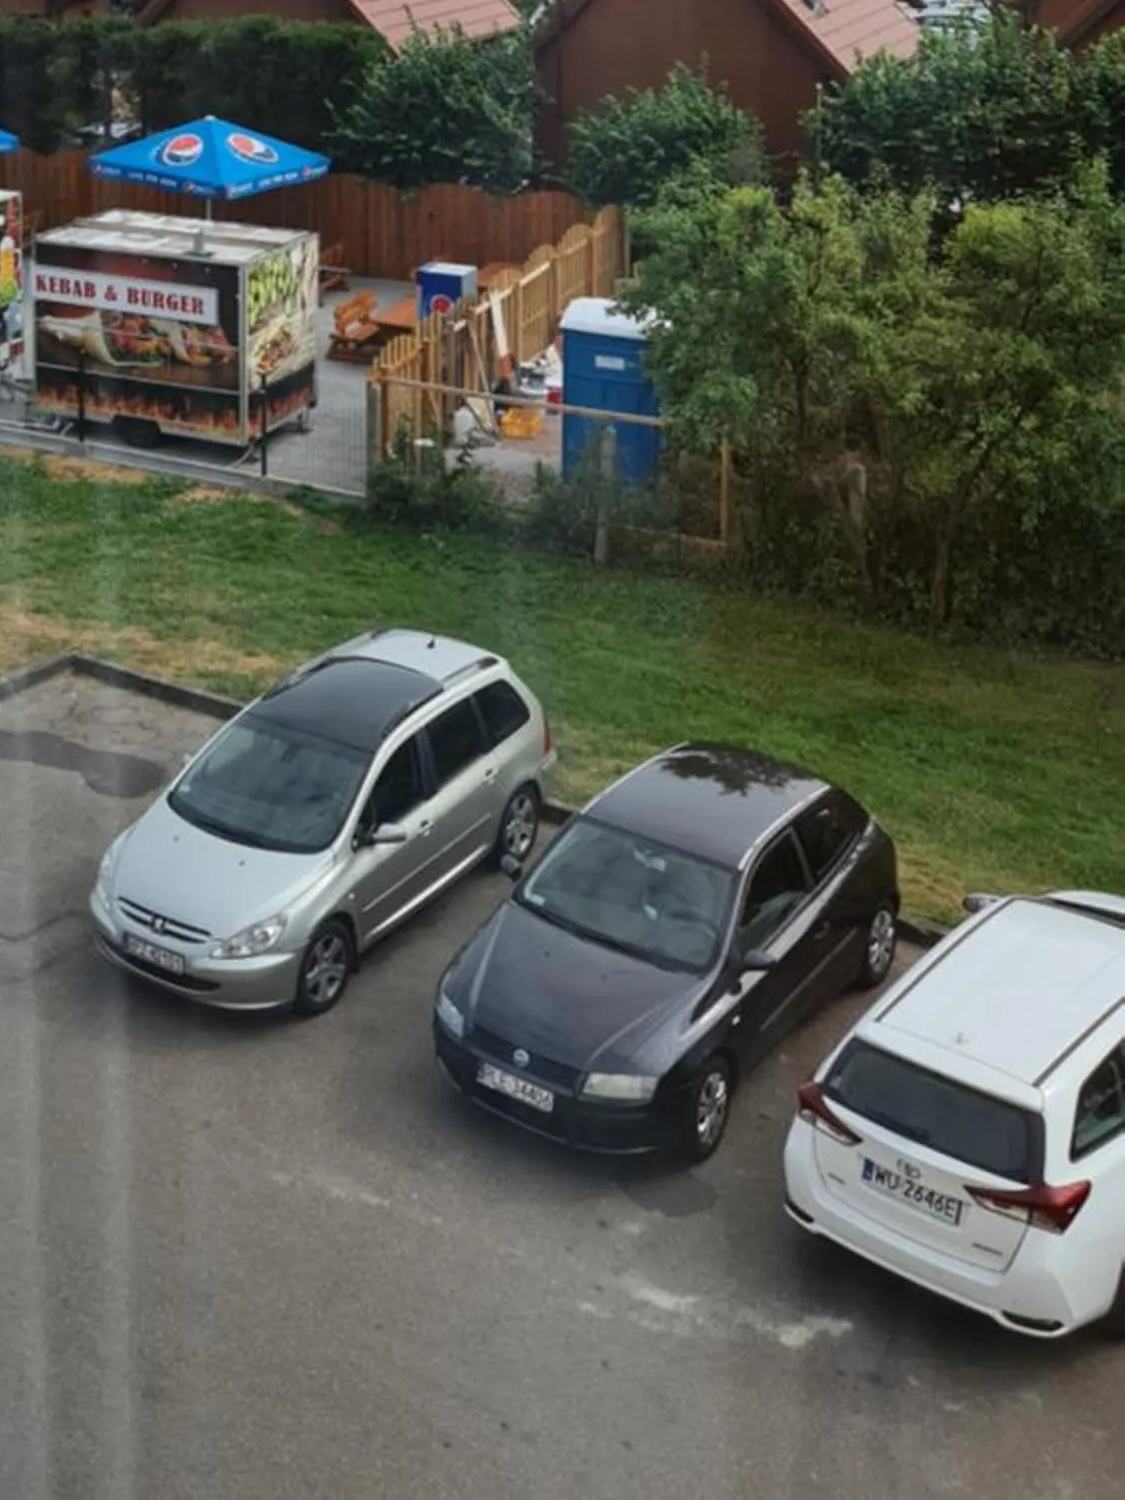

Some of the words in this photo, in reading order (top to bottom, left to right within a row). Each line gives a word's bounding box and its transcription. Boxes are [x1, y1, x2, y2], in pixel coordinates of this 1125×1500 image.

[35, 274, 97, 299] KEBAB
[103, 284, 119, 302] &
[126, 286, 205, 316] BURGER
[875, 1165, 900, 1190] WU
[903, 1179, 957, 1219] 2646E
